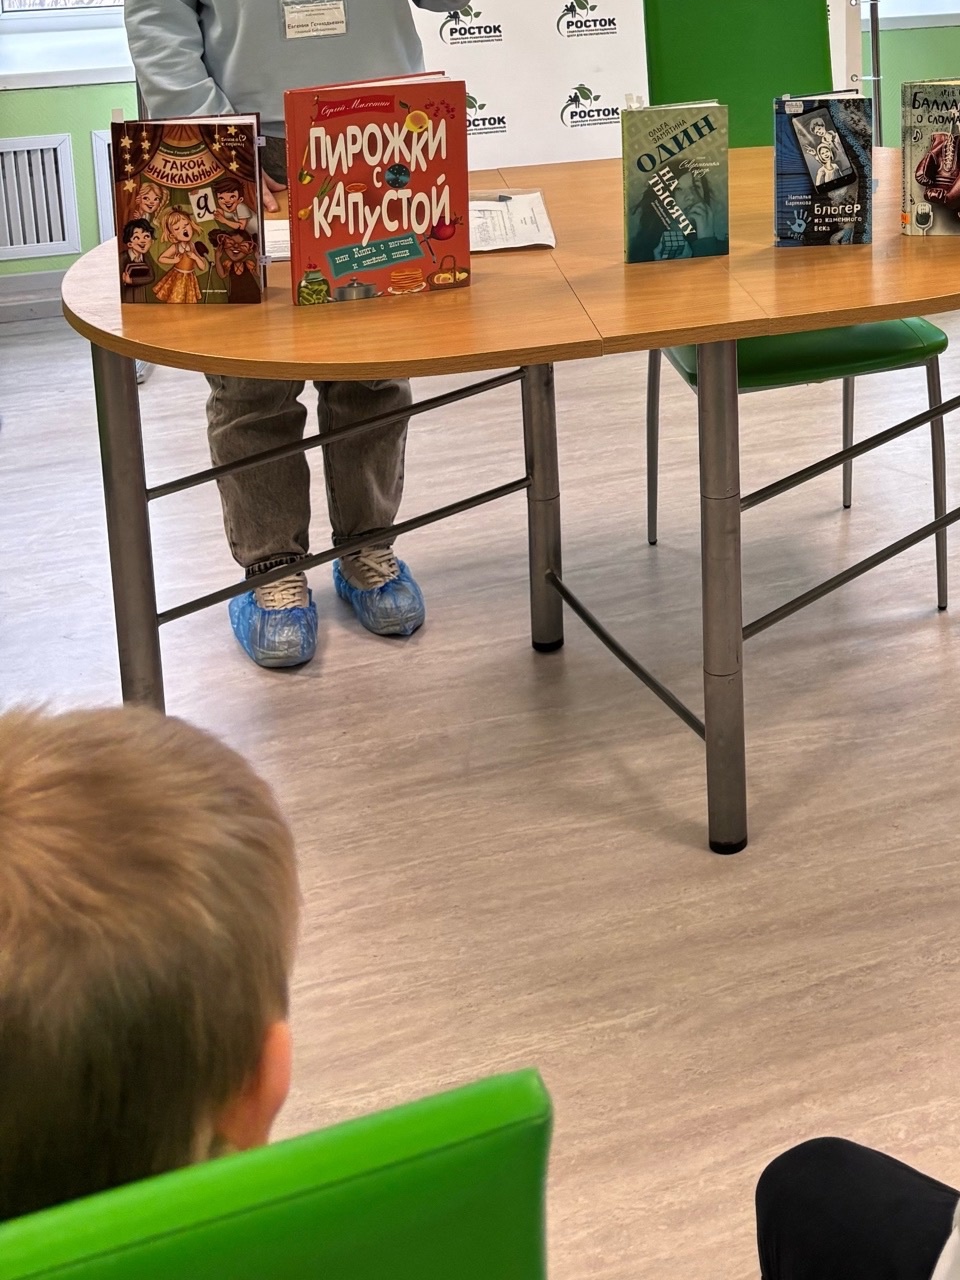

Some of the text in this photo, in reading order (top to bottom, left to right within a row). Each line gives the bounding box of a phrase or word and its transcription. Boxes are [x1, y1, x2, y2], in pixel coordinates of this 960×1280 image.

[450, 24, 502, 37] РОСТОК
[566, 17, 616, 29] РОСТОК
[467, 116, 506, 127] ОСТОК
[570, 107, 620, 120] РОСТОК
[648, 121, 670, 138] ОЛЬГА
[651, 119, 688, 144] ЗАМЯТИНА
[309, 118, 447, 177] ПИРОЖКИ
[637, 114, 717, 173] ОДИН
[147, 160, 221, 184] УНИКАЛЬНЫЙ
[161, 156, 206, 172] ТАКОЙ
[658, 166, 679, 191] НА
[313, 173, 450, 247] КАПУСТОЙ
[647, 173, 696, 236] ТЫСЯЧУ
[814, 203, 861, 215] Блогер
